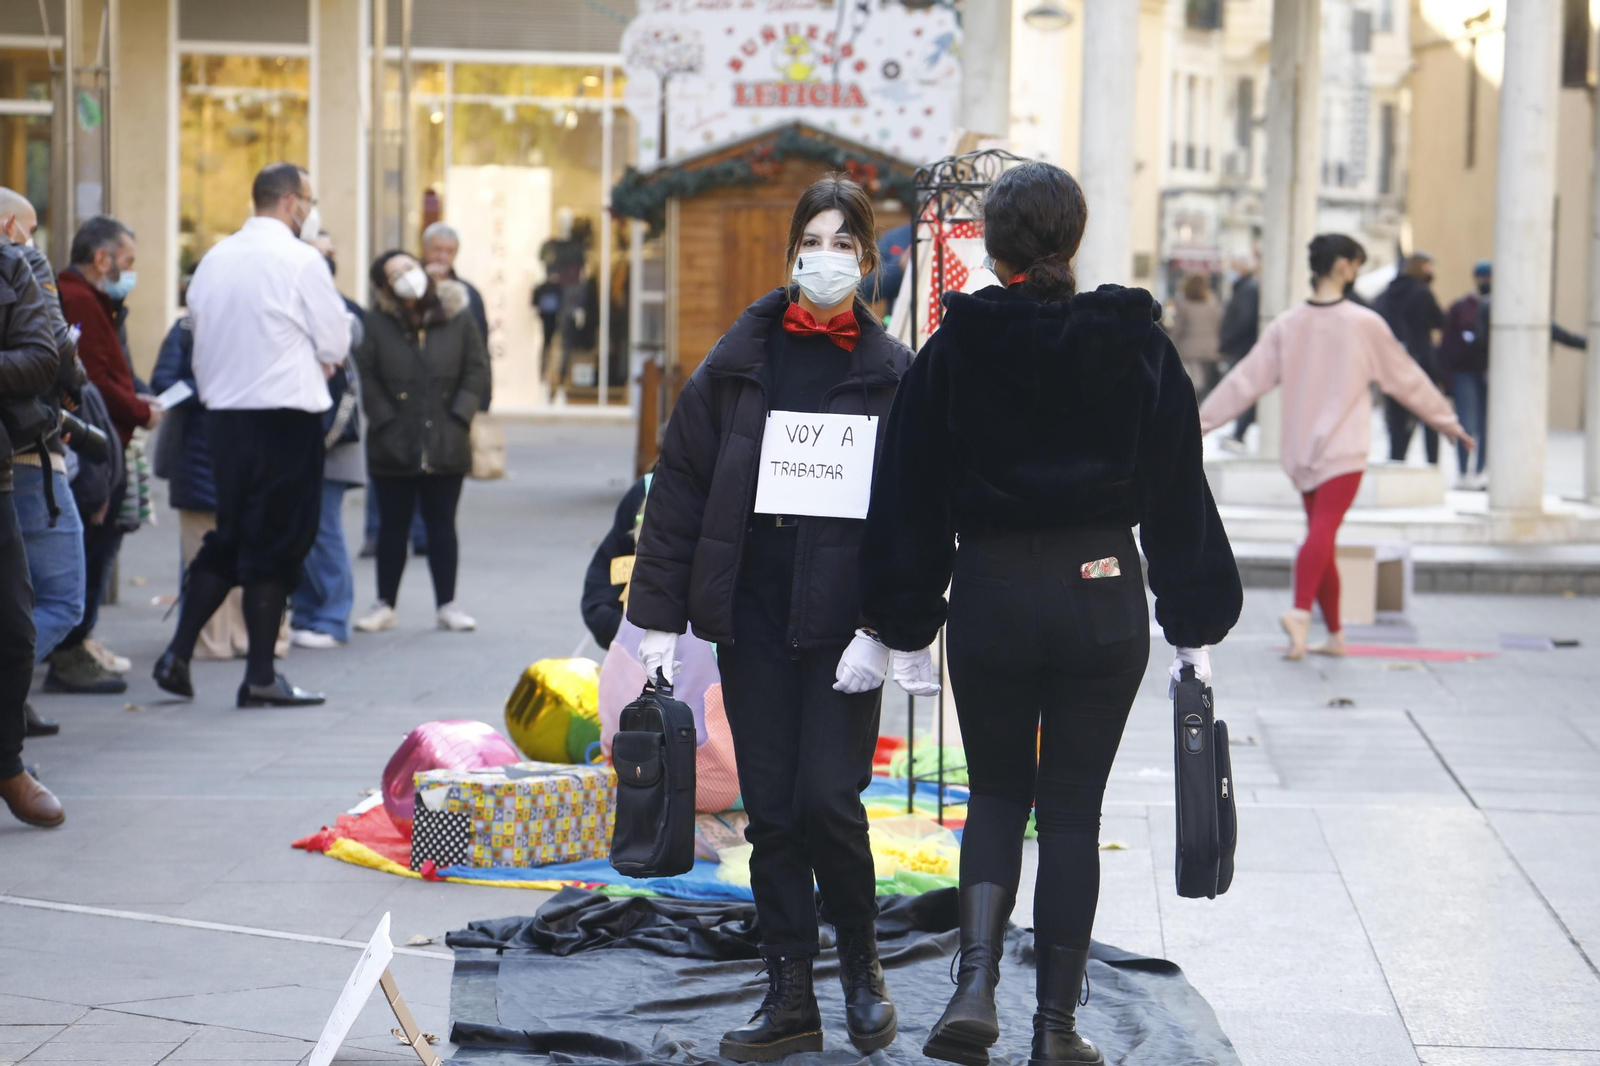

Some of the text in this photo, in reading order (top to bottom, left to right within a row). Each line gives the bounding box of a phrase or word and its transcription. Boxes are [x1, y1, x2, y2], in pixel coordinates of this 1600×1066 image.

[733, 82, 868, 107] LETICIA
[785, 424, 854, 447] VOY A
[770, 461, 843, 480] TRABAJAR
